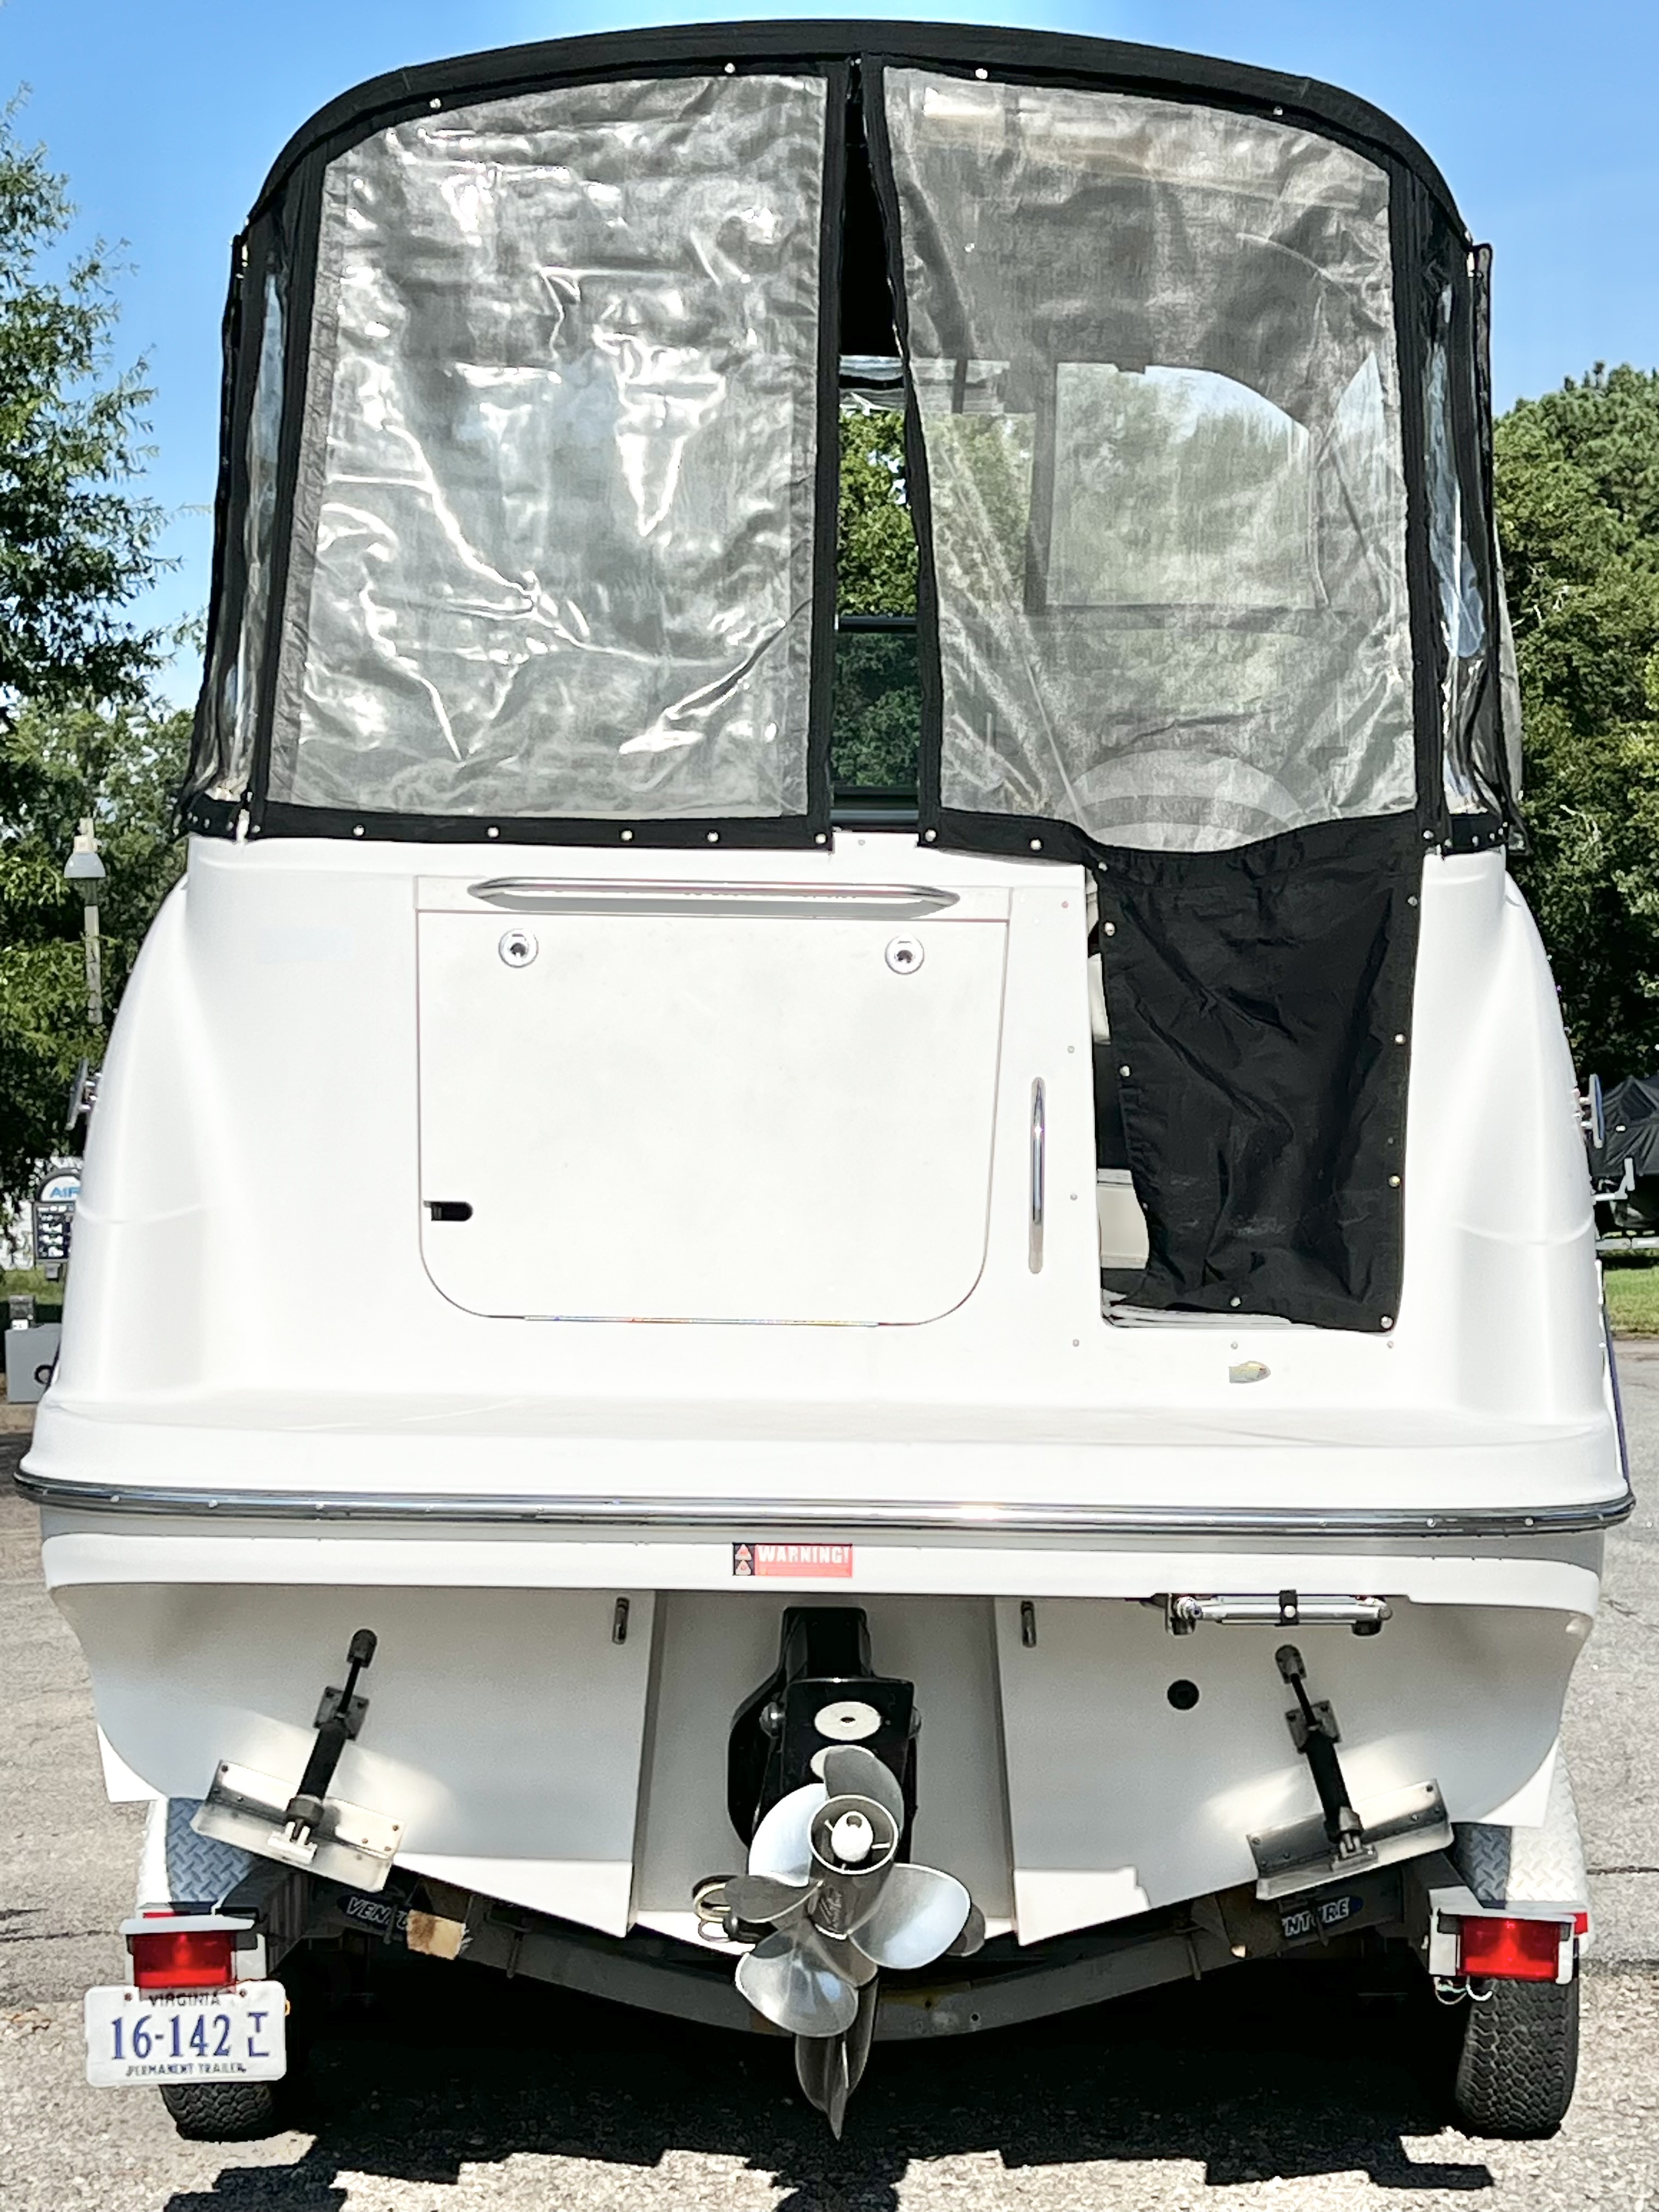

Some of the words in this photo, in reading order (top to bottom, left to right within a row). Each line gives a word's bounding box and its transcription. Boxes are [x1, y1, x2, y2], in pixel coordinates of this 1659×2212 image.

[758, 1545, 849, 1564] WARNING!
[149, 1993, 220, 2007] VIRGINIA
[111, 2015, 232, 2059] 16-142
[126, 2063, 194, 2076] PERMANENT
[198, 2062, 247, 2074] TRAILER
